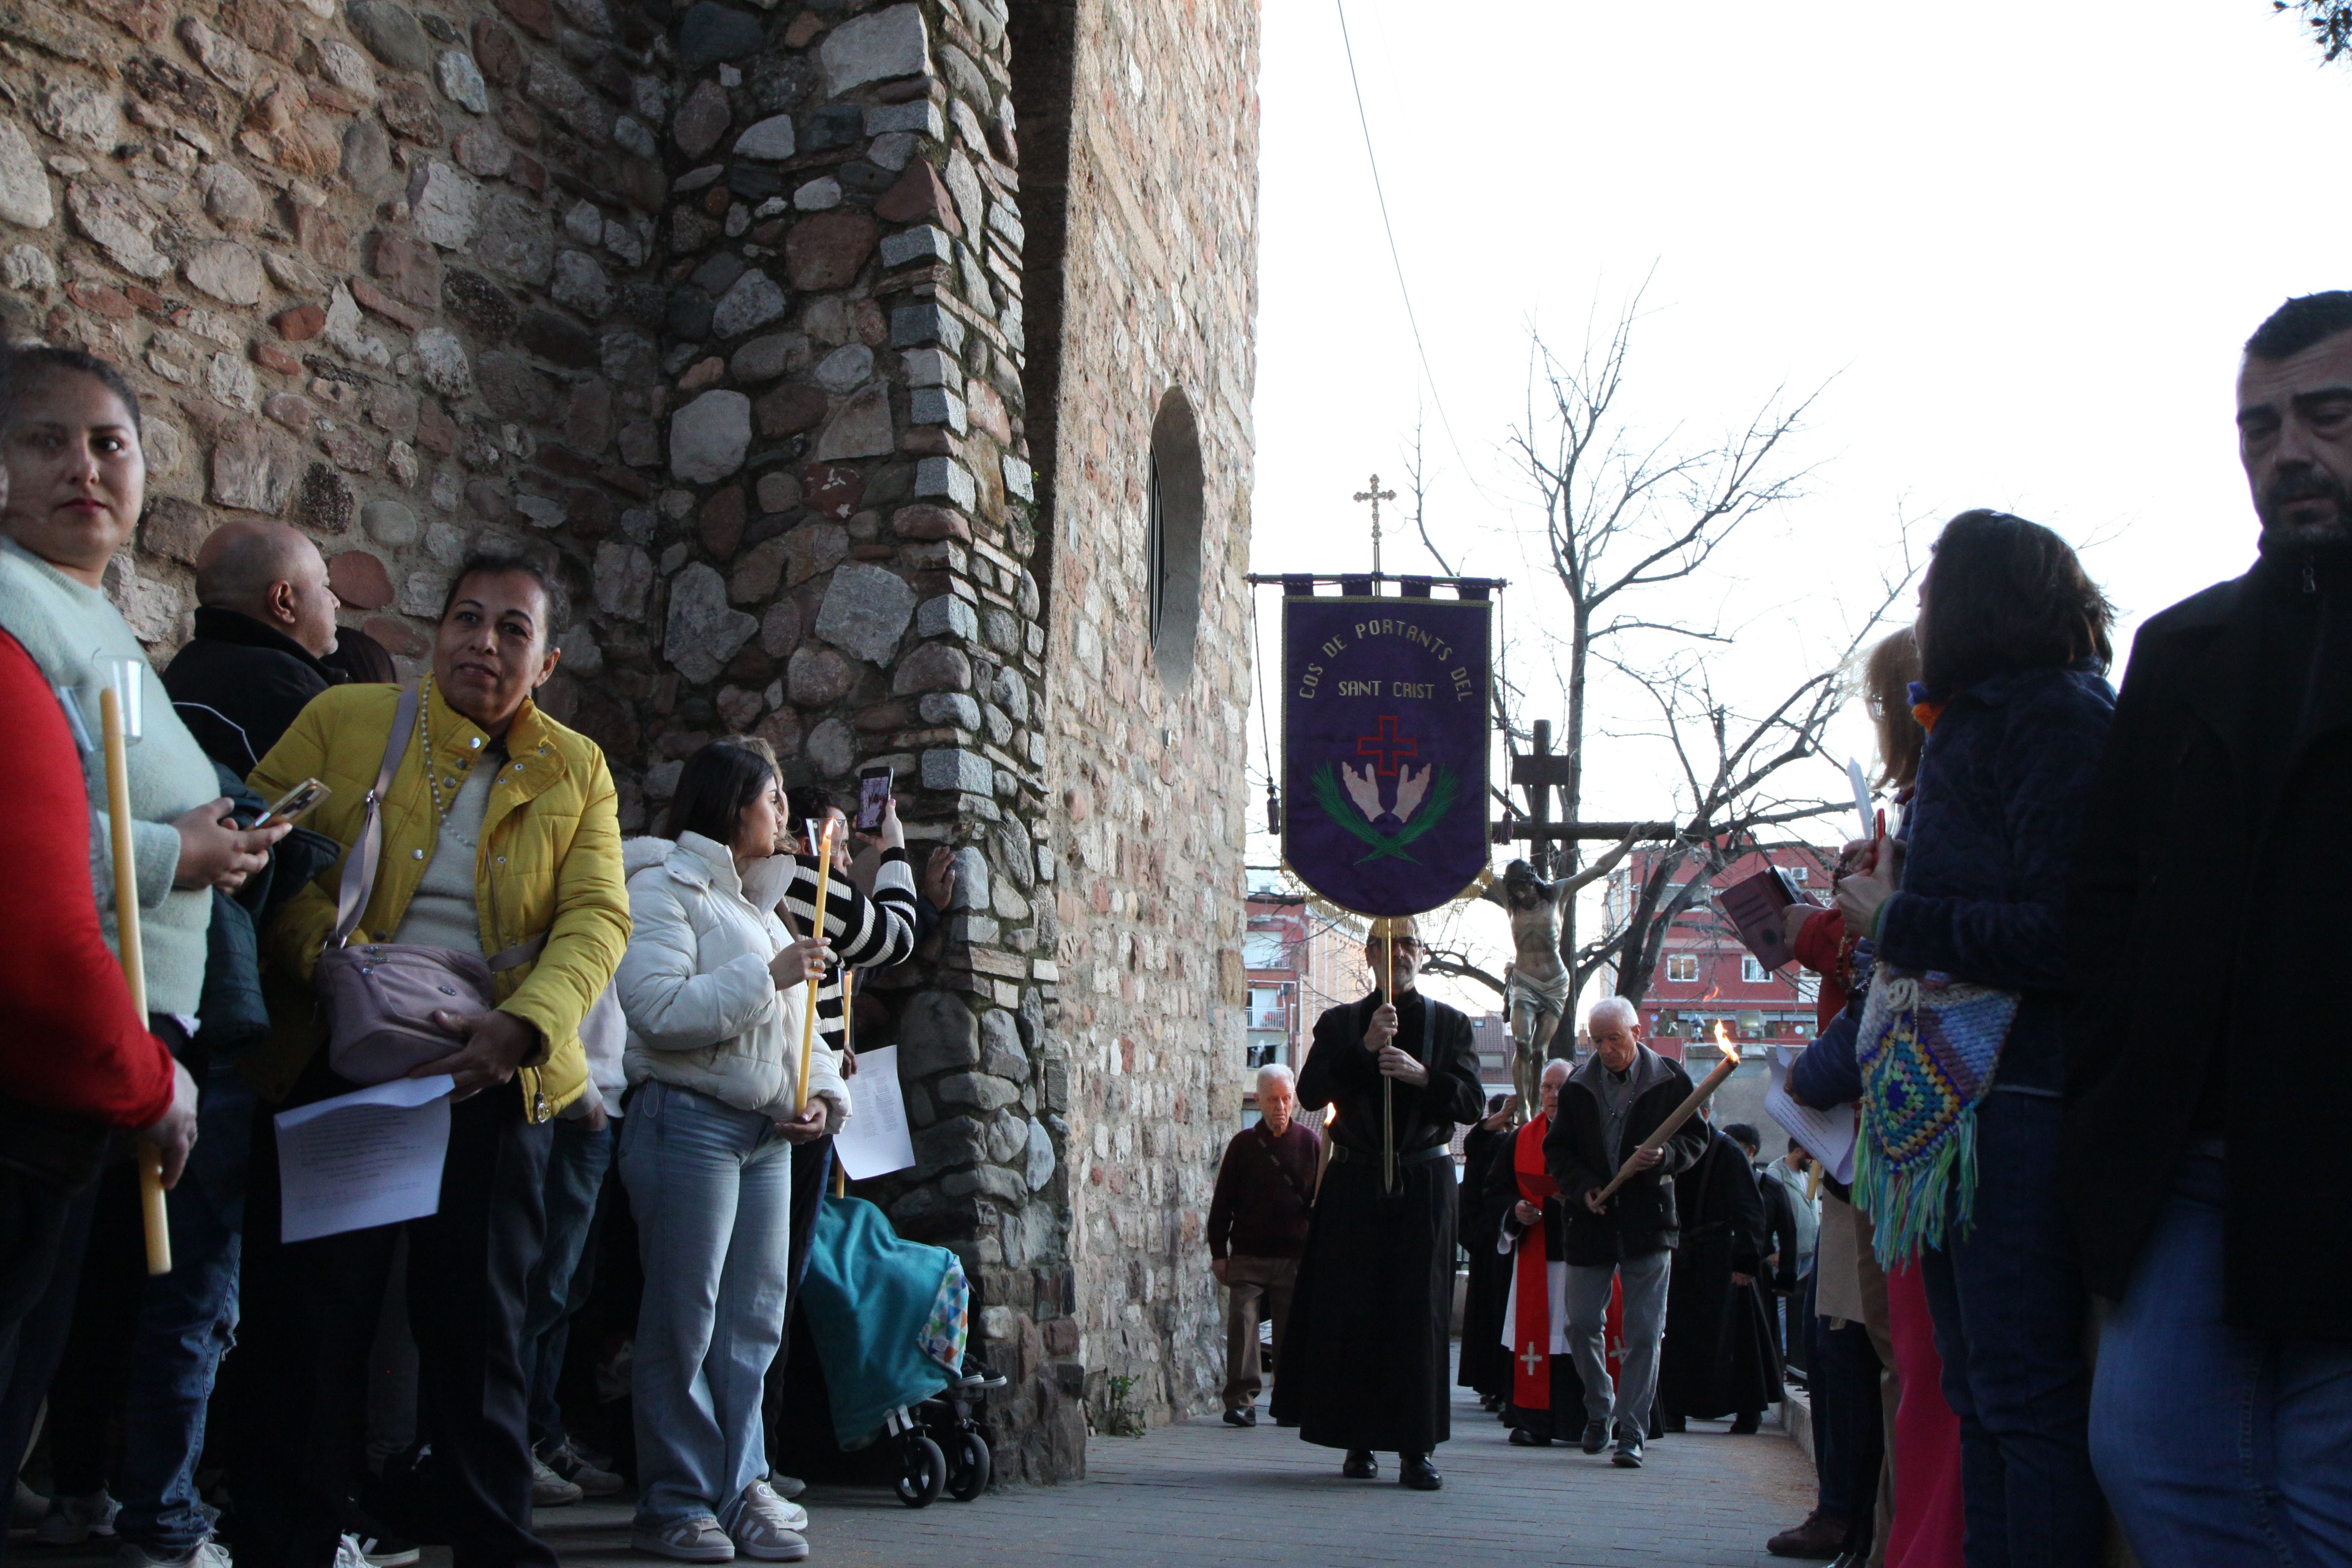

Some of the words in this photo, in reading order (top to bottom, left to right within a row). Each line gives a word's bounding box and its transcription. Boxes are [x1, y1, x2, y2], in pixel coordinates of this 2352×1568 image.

[1299, 663, 1323, 699] COS
[1322, 634, 1348, 658] DE
[1355, 619, 1453, 661] PORTANTS
[1450, 667, 1473, 701] DEL
[1338, 681, 1382, 696] SANT
[1393, 682, 1435, 699] CRIST
